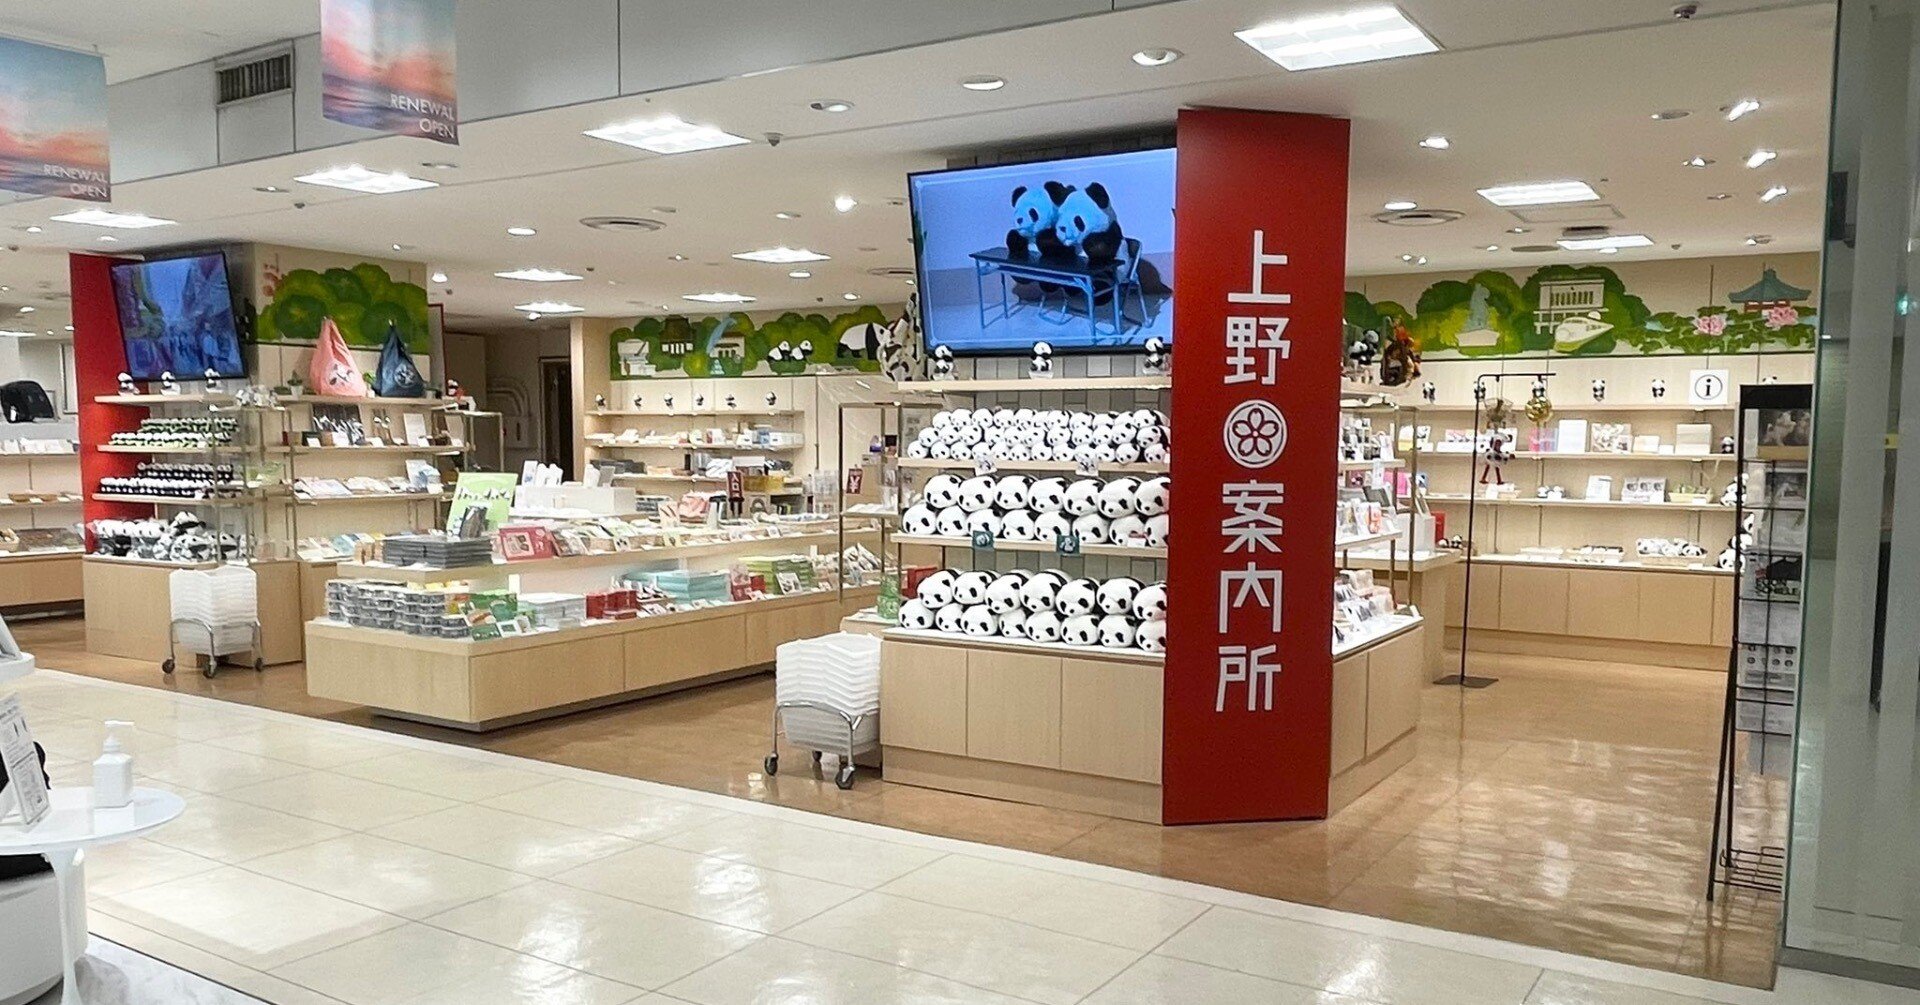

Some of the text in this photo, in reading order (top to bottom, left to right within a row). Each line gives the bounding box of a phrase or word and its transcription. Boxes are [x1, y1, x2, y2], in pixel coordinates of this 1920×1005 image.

[390, 93, 455, 121] RENEWAL
[419, 118, 455, 138] OPEN
[44, 164, 108, 183] RENEWAL
[70, 183, 107, 197] OPEN
